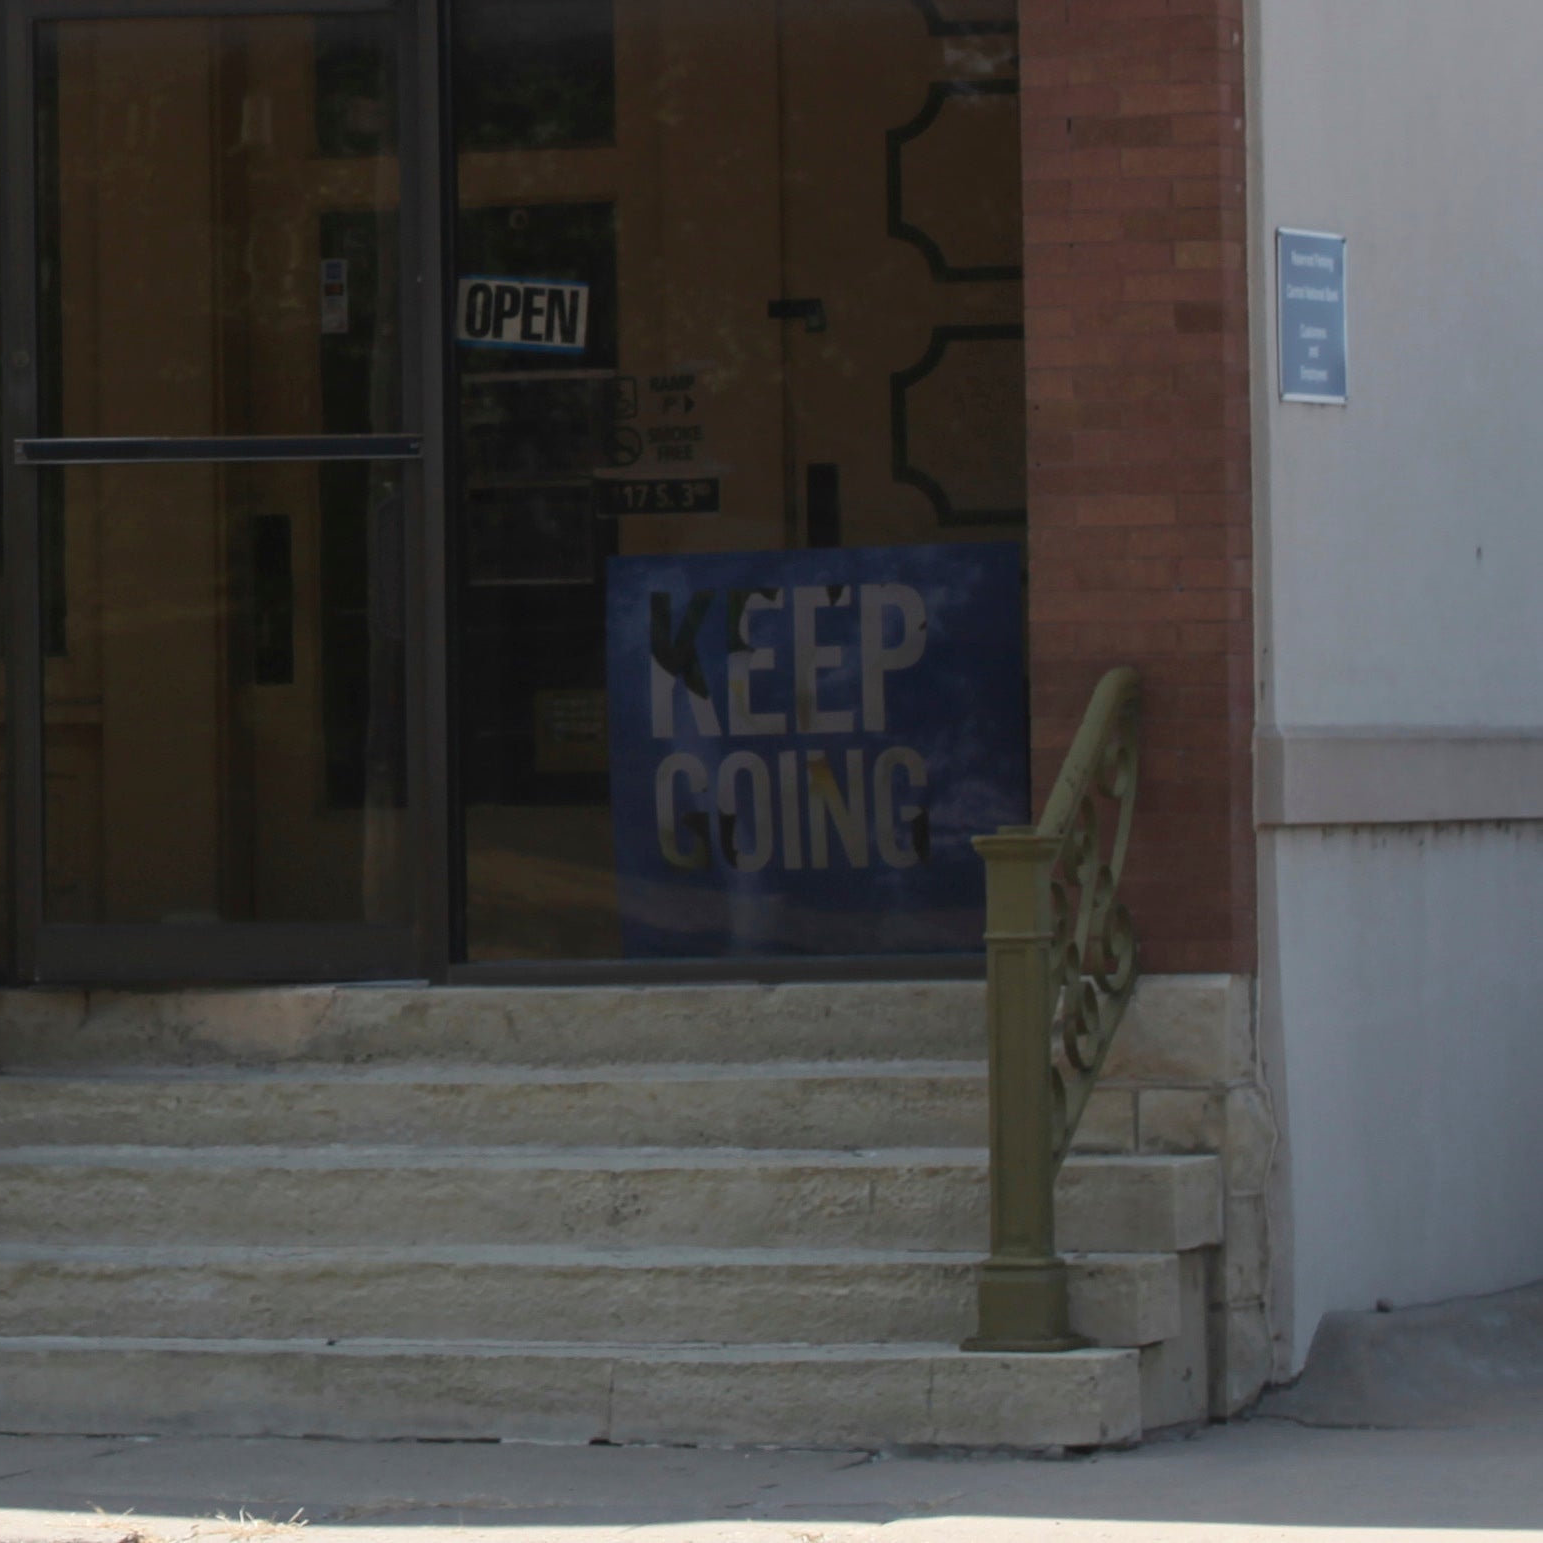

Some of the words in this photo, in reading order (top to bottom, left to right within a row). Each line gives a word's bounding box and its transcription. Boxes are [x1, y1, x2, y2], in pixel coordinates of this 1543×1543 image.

[465, 283, 580, 344] OPEN
[650, 584, 929, 740] KEEP
[654, 746, 932, 874] GOING
